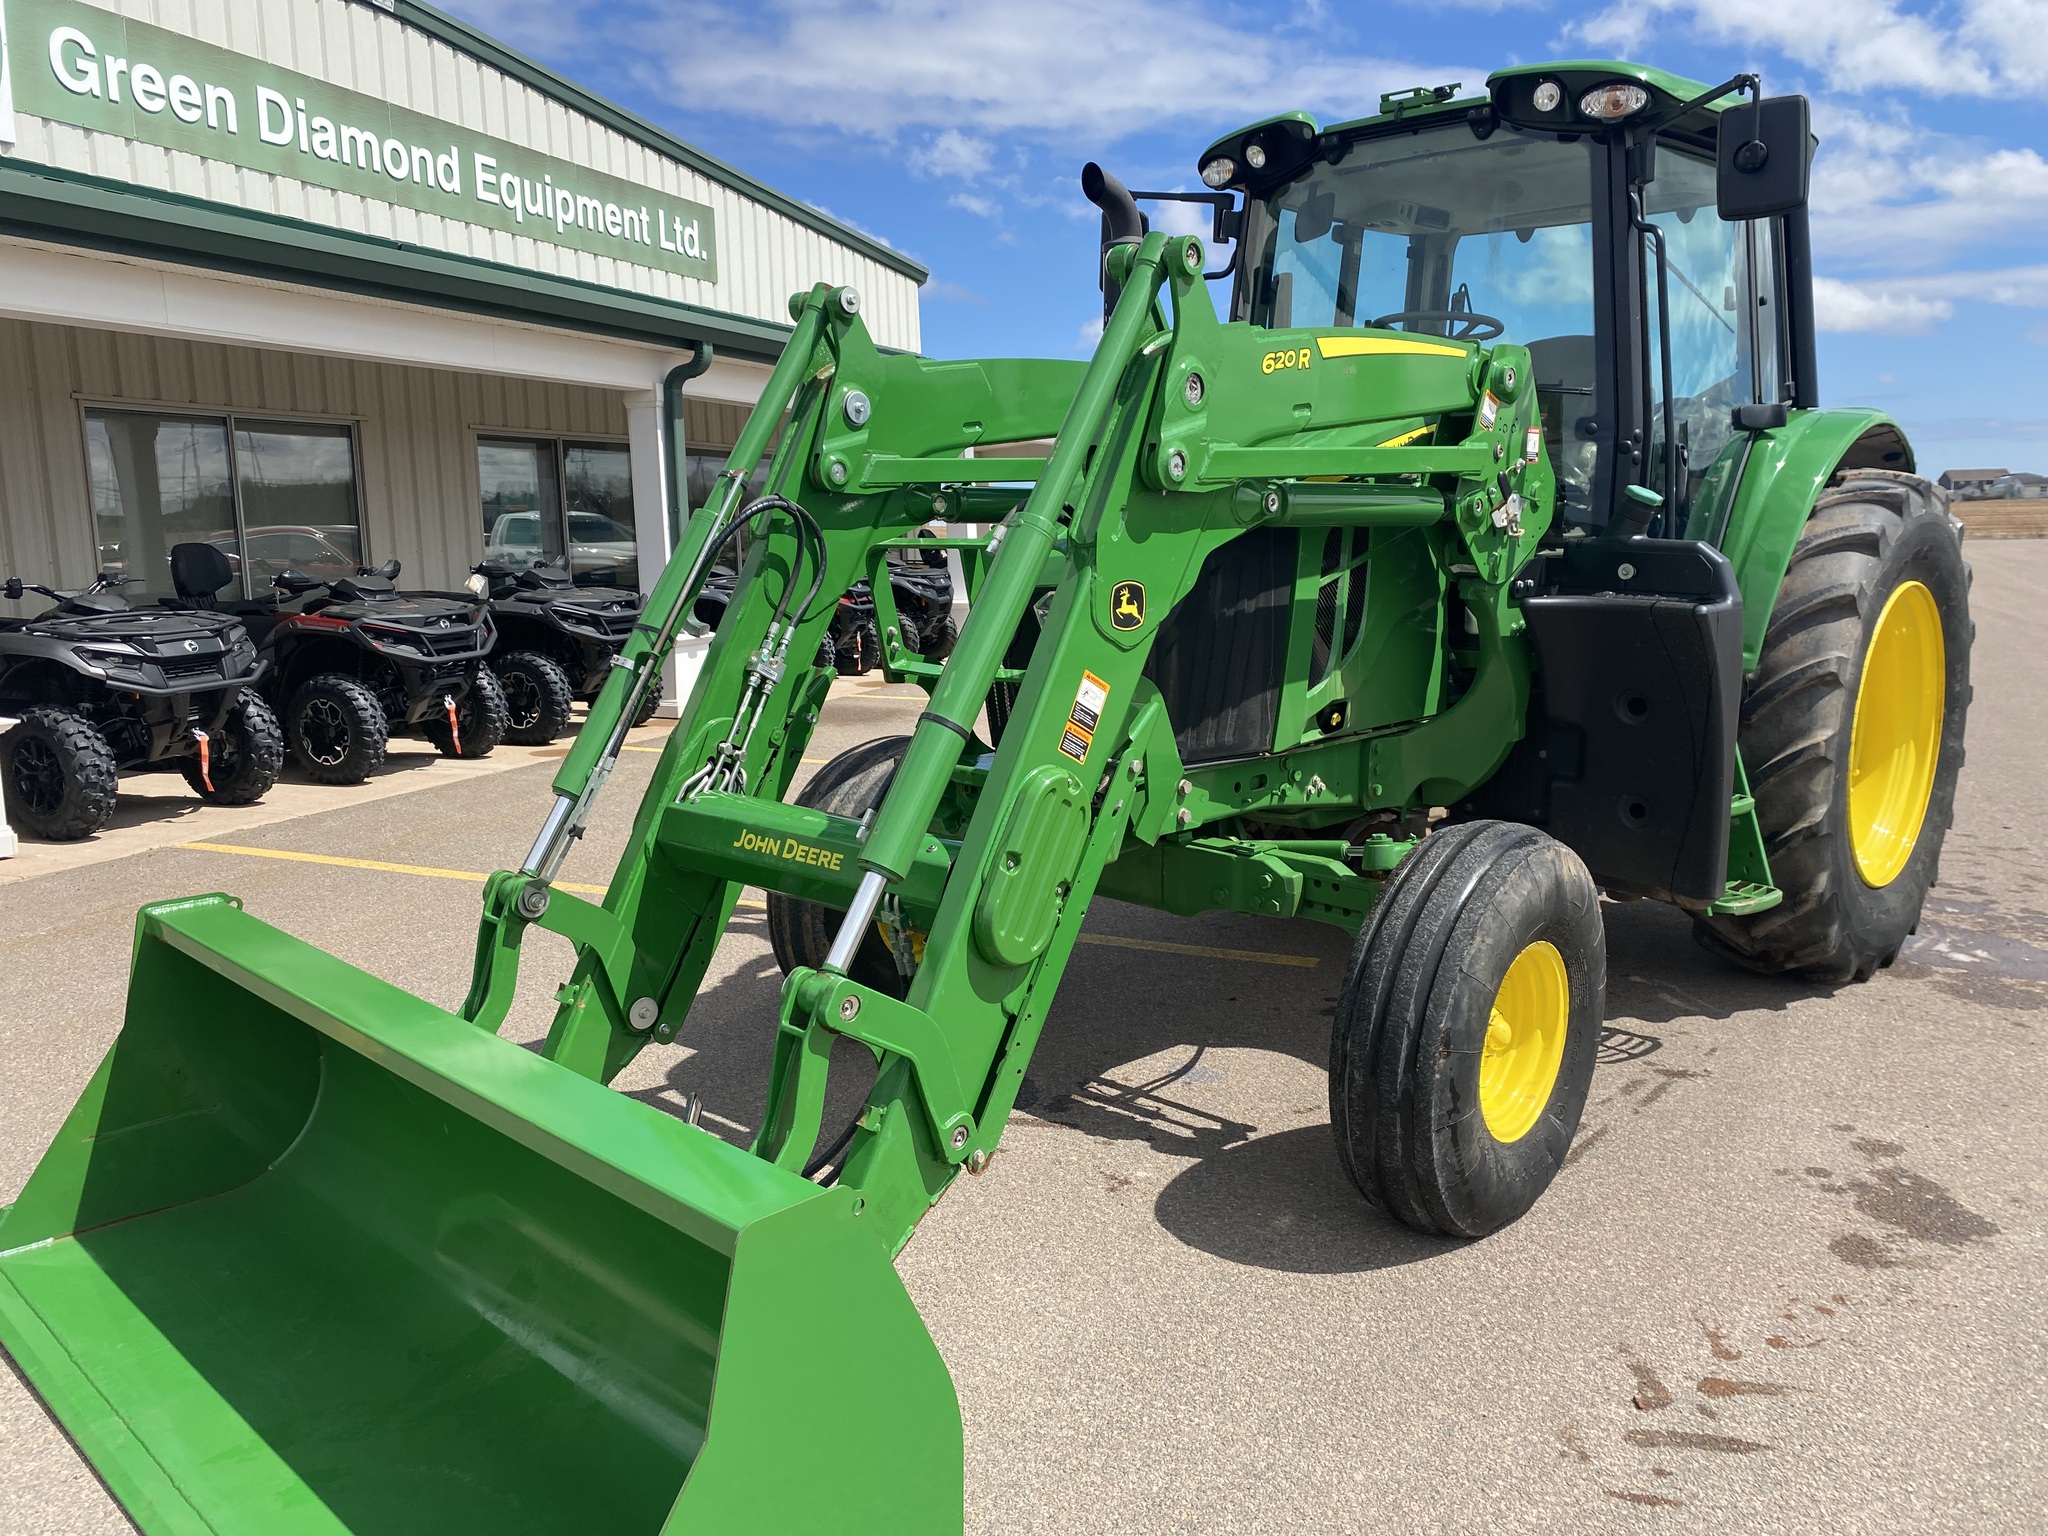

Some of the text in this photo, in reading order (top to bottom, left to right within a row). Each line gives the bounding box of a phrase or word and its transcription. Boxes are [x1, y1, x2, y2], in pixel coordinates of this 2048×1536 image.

[49, 26, 708, 260] Green Diamond Equipment Ltd.
[1262, 347, 1312, 375] 620 R
[733, 828, 844, 871] JOHN DEERE
